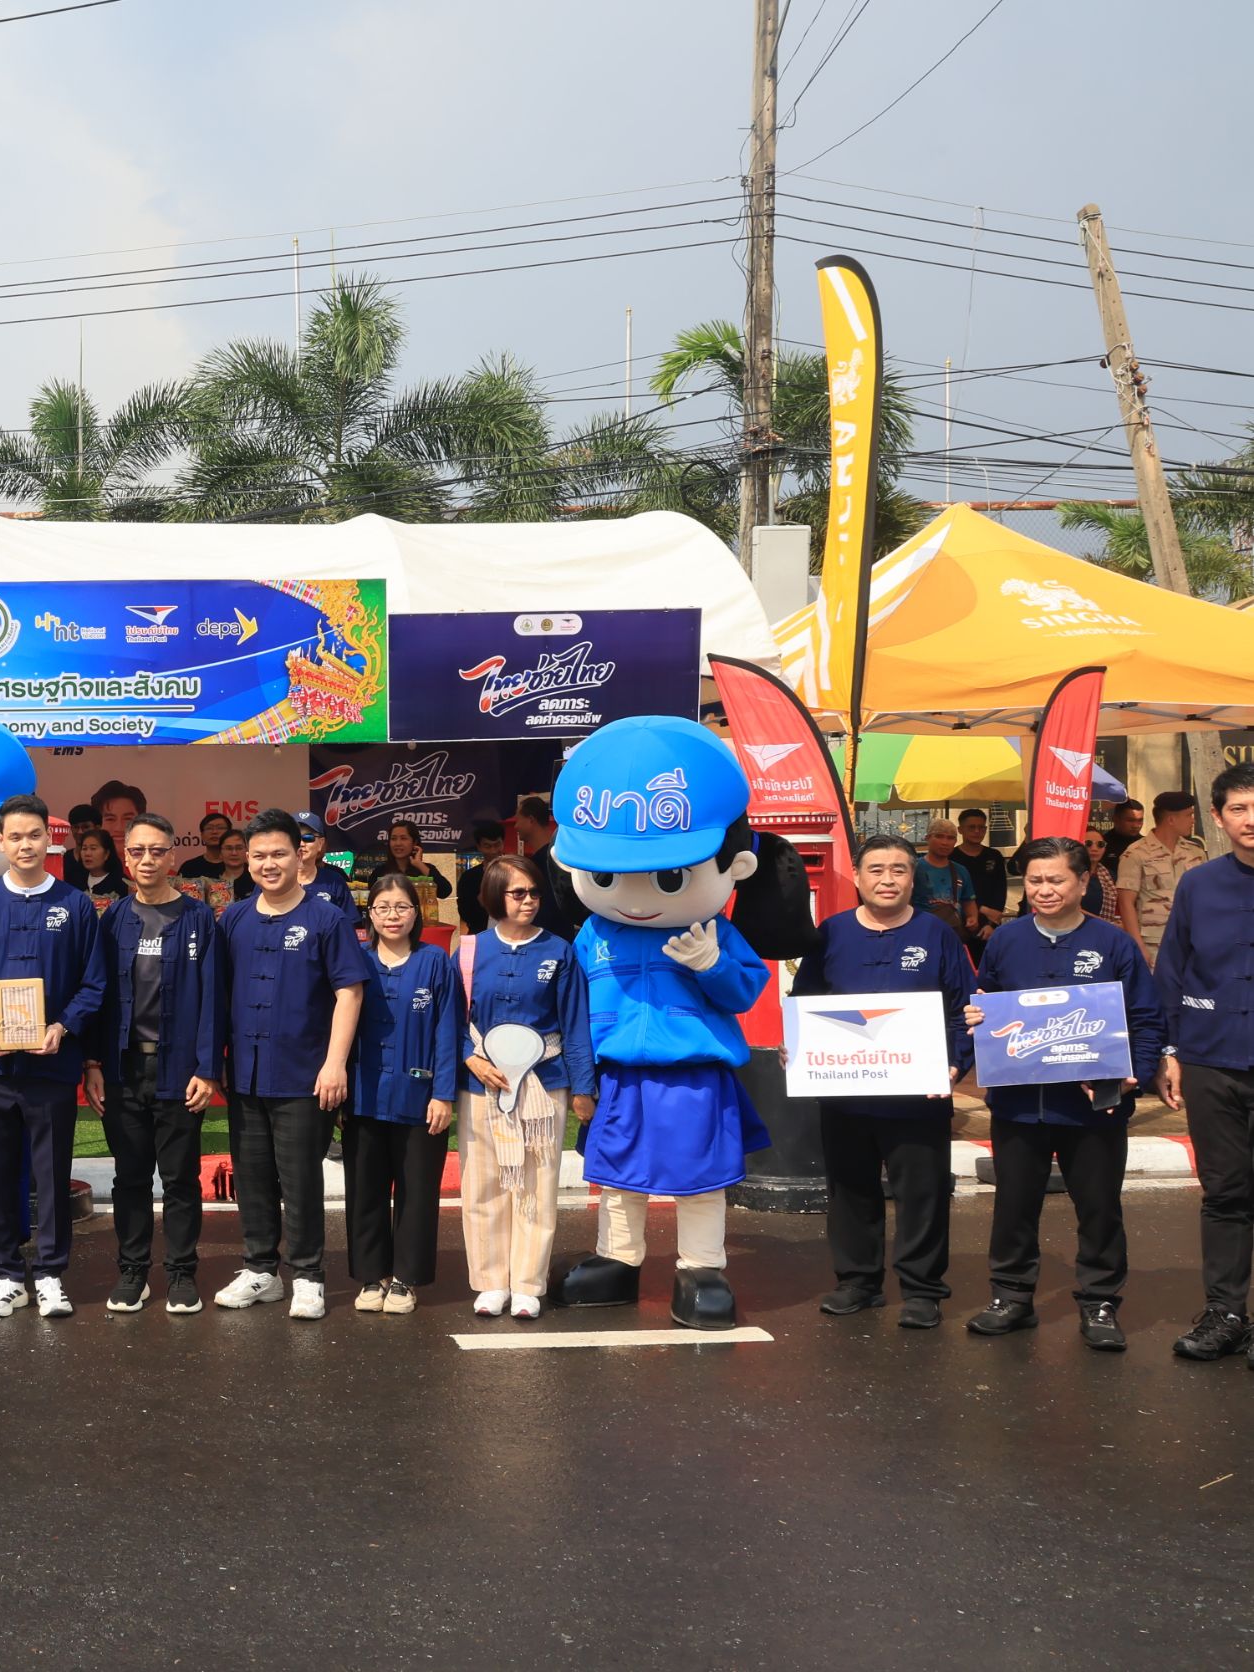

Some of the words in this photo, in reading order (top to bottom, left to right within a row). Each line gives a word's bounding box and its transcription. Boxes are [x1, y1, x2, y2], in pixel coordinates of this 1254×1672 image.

[197, 617, 241, 639] depa
[1020, 611, 1143, 630] SINGHA
[54, 621, 79, 641] nt
[538, 697, 590, 711] ลดภาระ
[51, 718, 84, 734] and
[89, 717, 154, 736] Society
[525, 712, 603, 726] ลดค่าครองชีพ
[573, 767, 691, 832] มาดี
[805, 1050, 913, 1067] ไปรษณีย์ไทย
[807, 1070, 860, 1081] Thailand
[861, 1069, 889, 1079] Post
